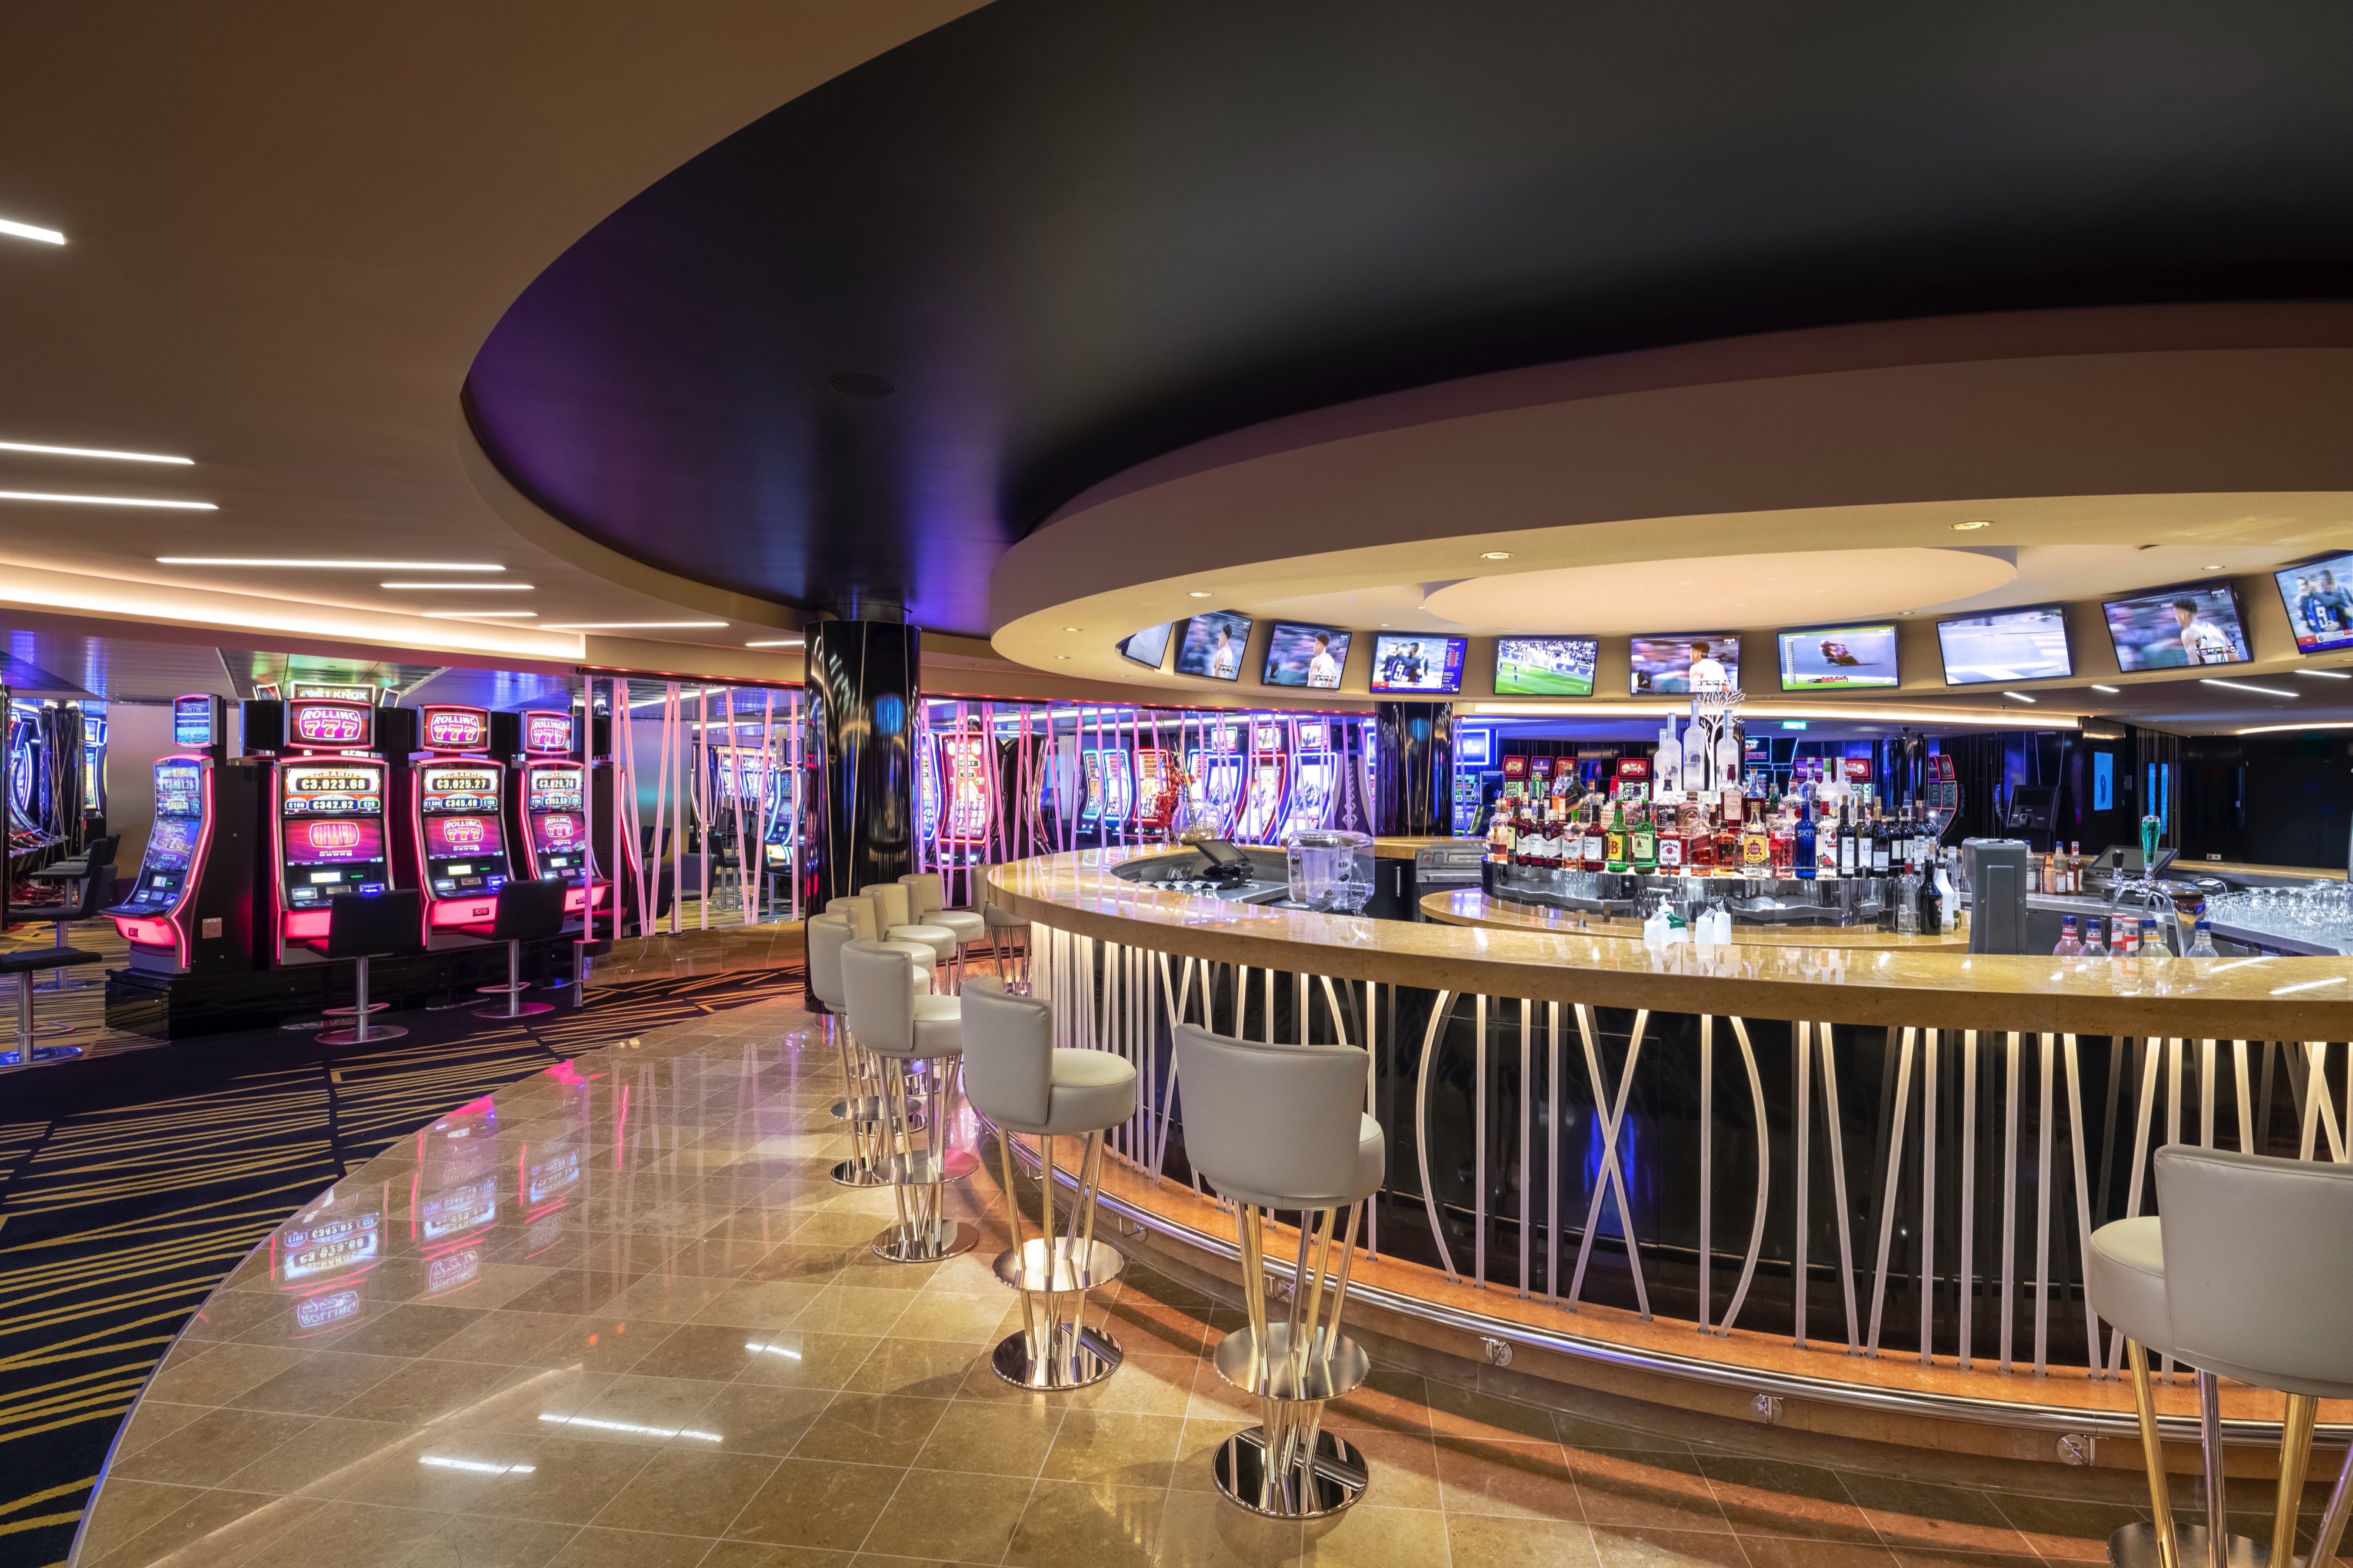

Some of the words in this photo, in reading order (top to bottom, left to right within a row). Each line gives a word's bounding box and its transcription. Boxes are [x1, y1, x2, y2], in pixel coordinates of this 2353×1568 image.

[1394, 665, 1405, 679] 9
[333, 690, 368, 700] KNOX
[302, 710, 359, 722] ROLLING
[434, 716, 478, 726] ROLLING
[532, 720, 565, 730] ROLLING
[302, 779, 365, 790] €3,023.68
[436, 779, 486, 790] €3,025.27
[313, 800, 354, 809] €342.62
[445, 799, 478, 808] €345.49
[445, 820, 481, 829] ROLLING
[166, 825, 186, 836] ROLLING
